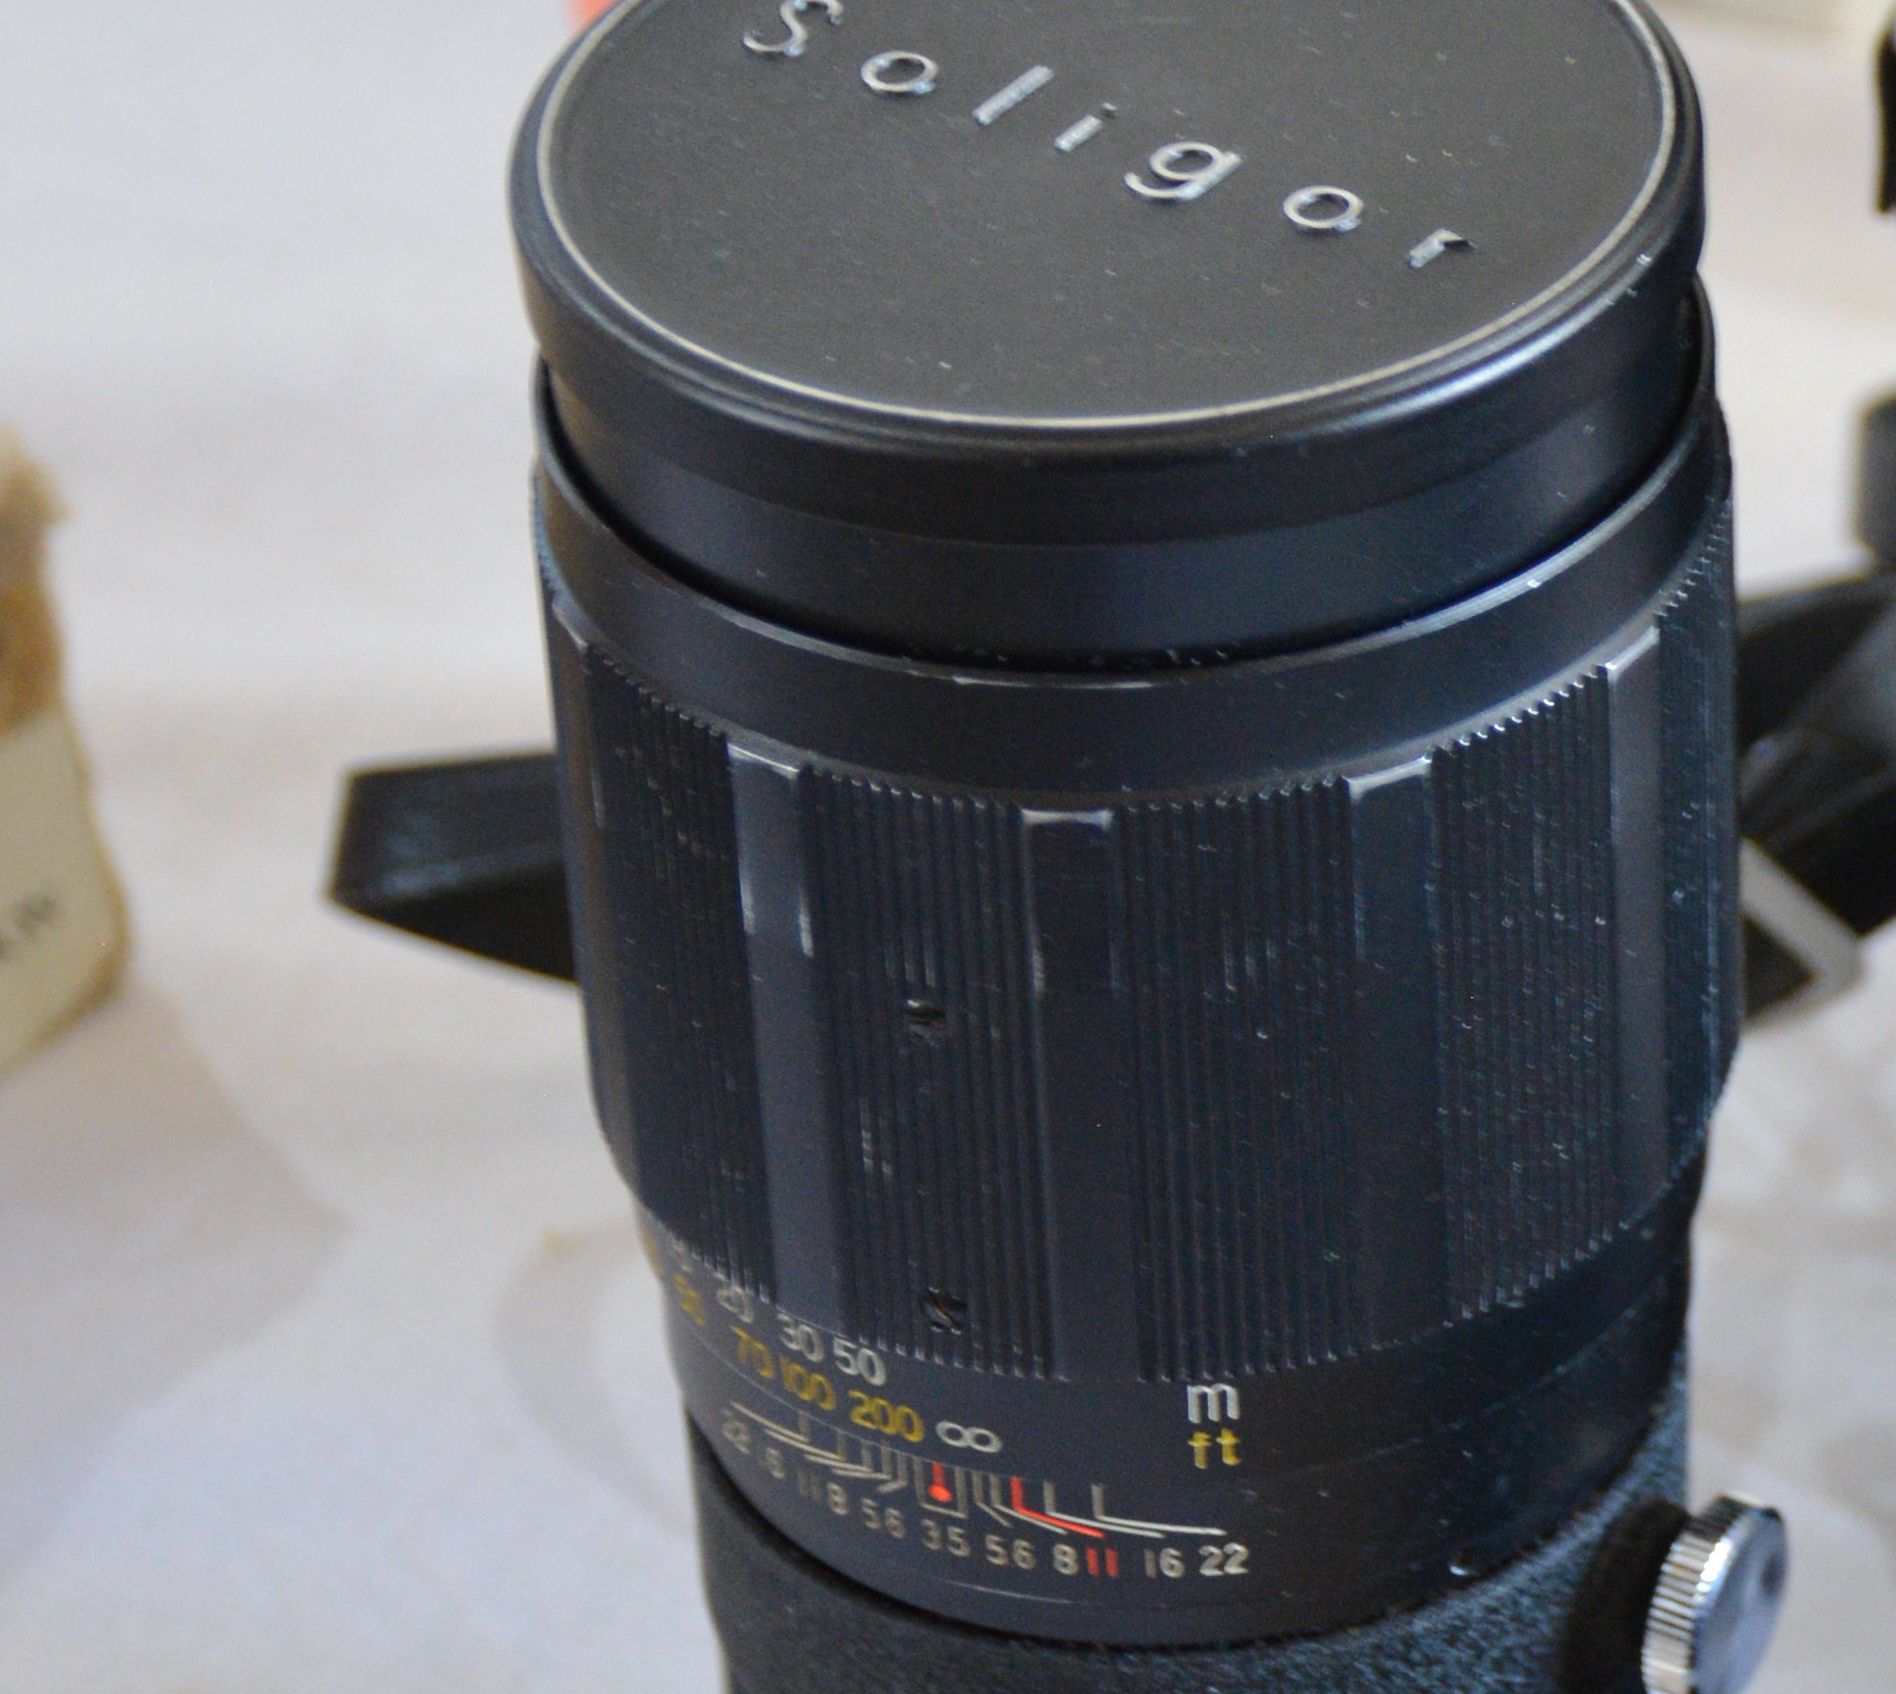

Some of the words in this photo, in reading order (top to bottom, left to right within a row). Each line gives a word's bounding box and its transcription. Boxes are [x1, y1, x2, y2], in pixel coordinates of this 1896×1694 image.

[776, 1312, 825, 1363] 30
[833, 1335, 887, 1387] 50
[779, 1355, 837, 1412] 100
[848, 1389, 925, 1443] 200
[1187, 1382, 1241, 1425] m
[1187, 1427, 1242, 1470] ft
[1053, 1543, 1080, 1577] 8
[1086, 1545, 1120, 1579] 11
[1143, 1546, 1187, 1579] 16
[1198, 1541, 1250, 1578] 22
